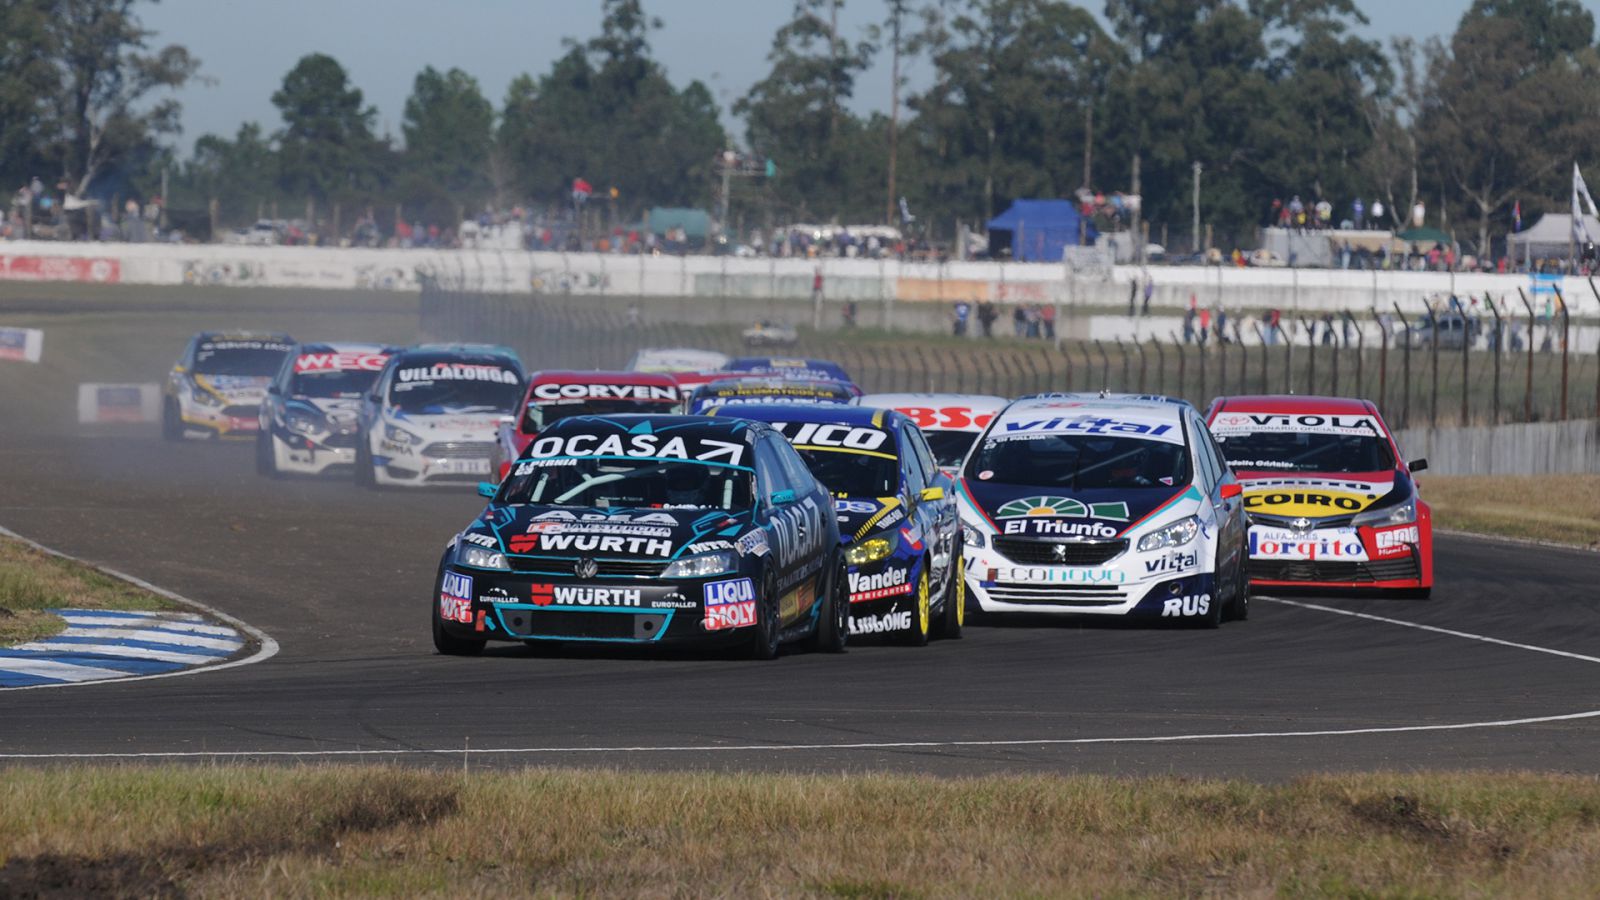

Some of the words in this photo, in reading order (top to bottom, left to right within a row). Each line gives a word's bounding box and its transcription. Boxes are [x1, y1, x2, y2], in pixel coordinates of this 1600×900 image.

[400, 366, 519, 385] VILLALONGA
[534, 383, 677, 400] CORVEN
[531, 434, 689, 459] OCASA
[1243, 493, 1362, 510] COIRO
[1004, 520, 1027, 534] El
[1032, 519, 1117, 537] Triunfo
[848, 566, 907, 593] Vander
[554, 587, 641, 606] WÜRTH
[706, 580, 753, 605] LIQUI
[708, 602, 756, 628] MOLY
[1161, 593, 1211, 617] RUS
